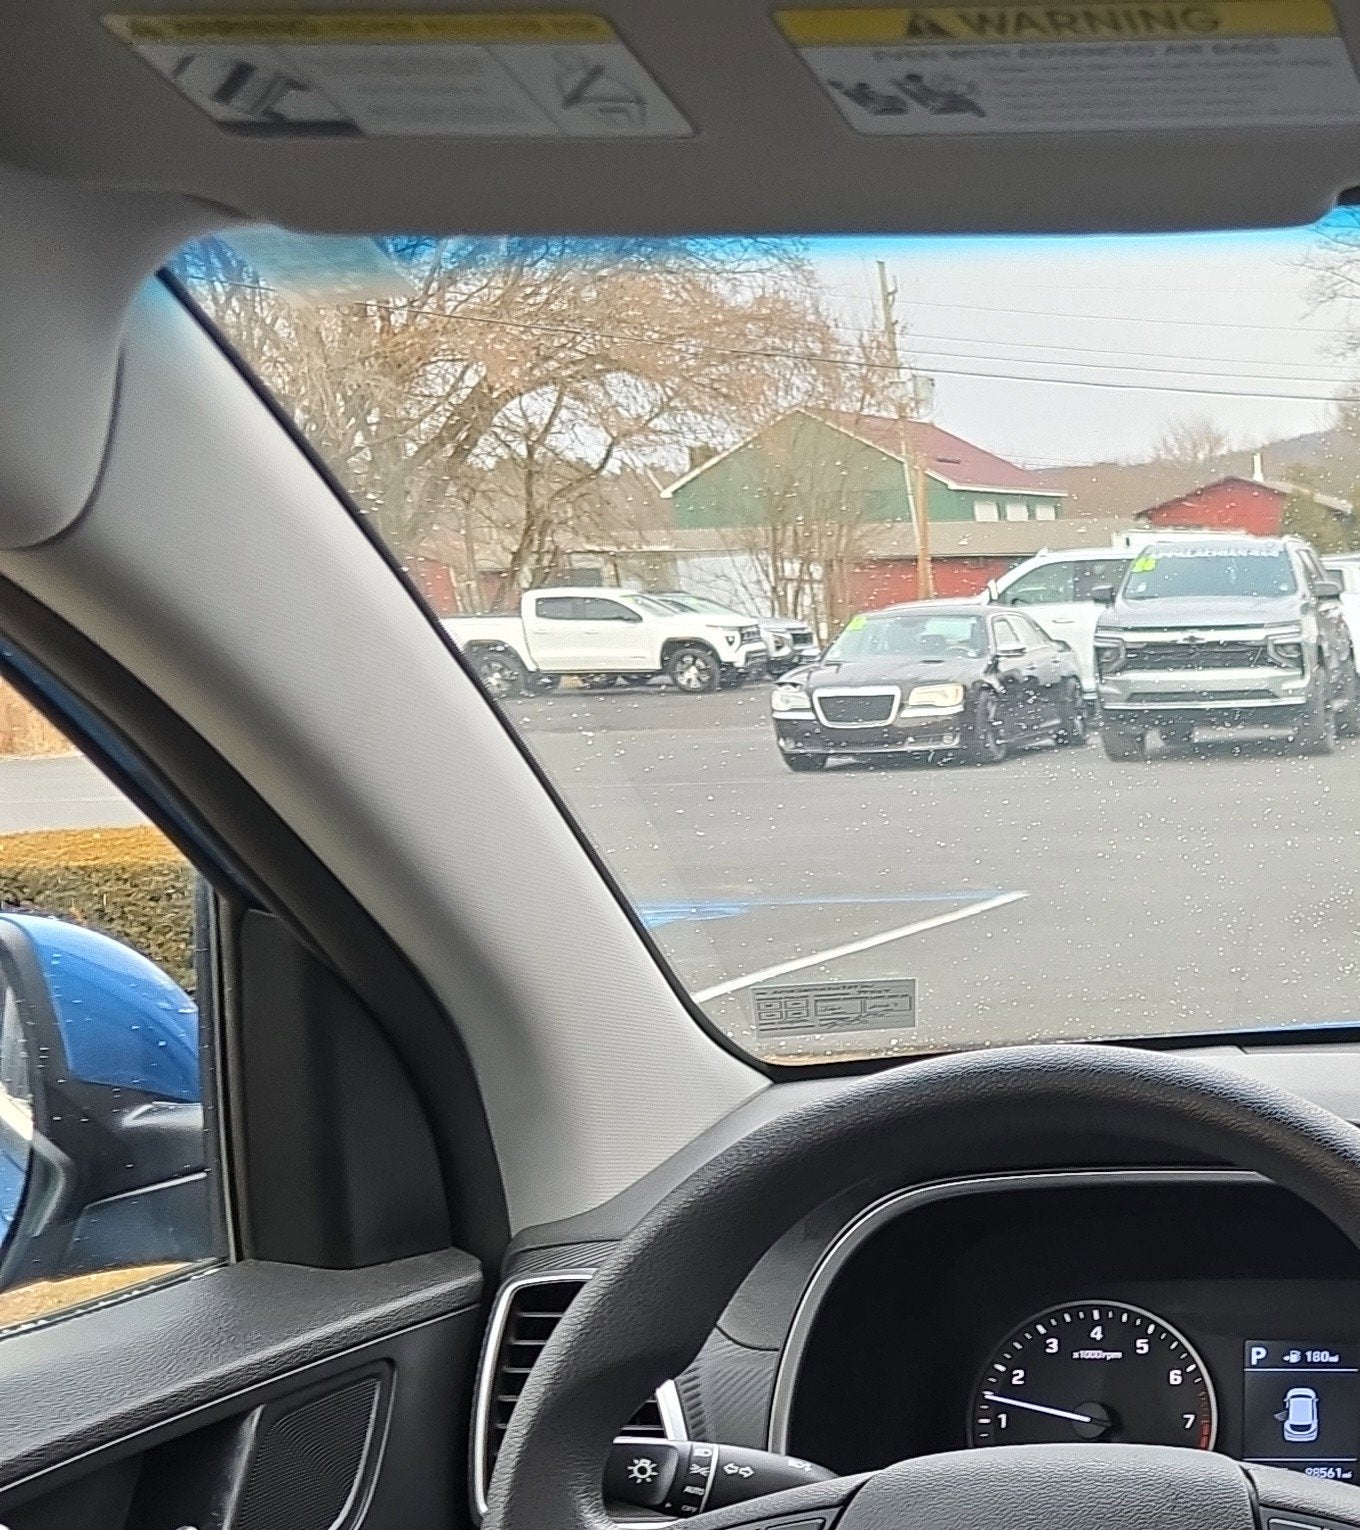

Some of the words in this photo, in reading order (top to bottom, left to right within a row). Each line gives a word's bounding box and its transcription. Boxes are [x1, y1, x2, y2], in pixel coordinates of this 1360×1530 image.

[956, 6, 1220, 37] WARNING
[1090, 1326, 1104, 1341] 4
[1045, 1338, 1059, 1354] 3
[1136, 1339, 1149, 1354] 5
[1251, 1347, 1267, 1366] P
[1012, 1369, 1025, 1385] 2
[1169, 1370, 1182, 1385] 6
[998, 1413, 1007, 1429] 1
[1183, 1414, 1195, 1429] 7
